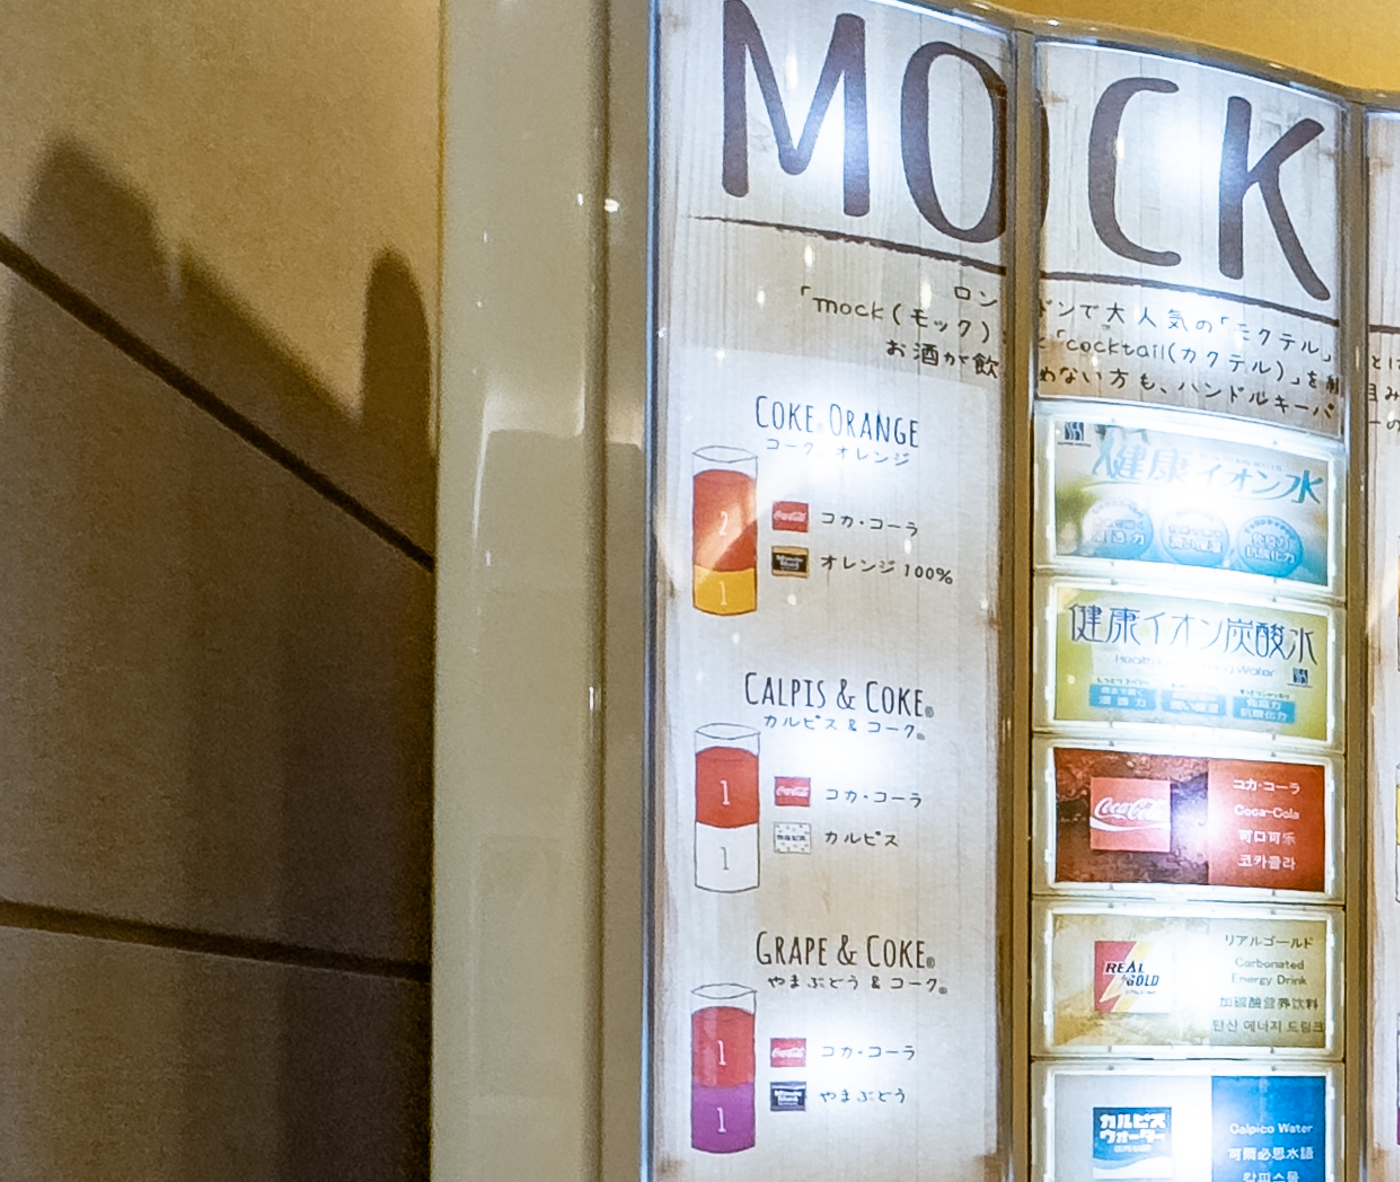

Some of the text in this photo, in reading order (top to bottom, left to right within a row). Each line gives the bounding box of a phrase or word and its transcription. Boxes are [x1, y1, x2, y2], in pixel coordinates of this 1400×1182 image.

[830, 403, 919, 448] ORANGE
[1069, 604, 1318, 665] 健康イオン炭酸水
[745, 672, 826, 709] CALPIS
[837, 678, 856, 711] &
[757, 931, 827, 966] GRAPE
[837, 934, 857, 966] &
[1225, 934, 1314, 950] リアルゴールド
[1104, 960, 1145, 974] REAL
[1235, 957, 1305, 970] Carbonated
[1125, 974, 1160, 987] GOLD
[1231, 973, 1307, 986] Energy Drink
[1099, 1112, 1167, 1128] カルピス
[1229, 1123, 1313, 1136] Calpico Water
